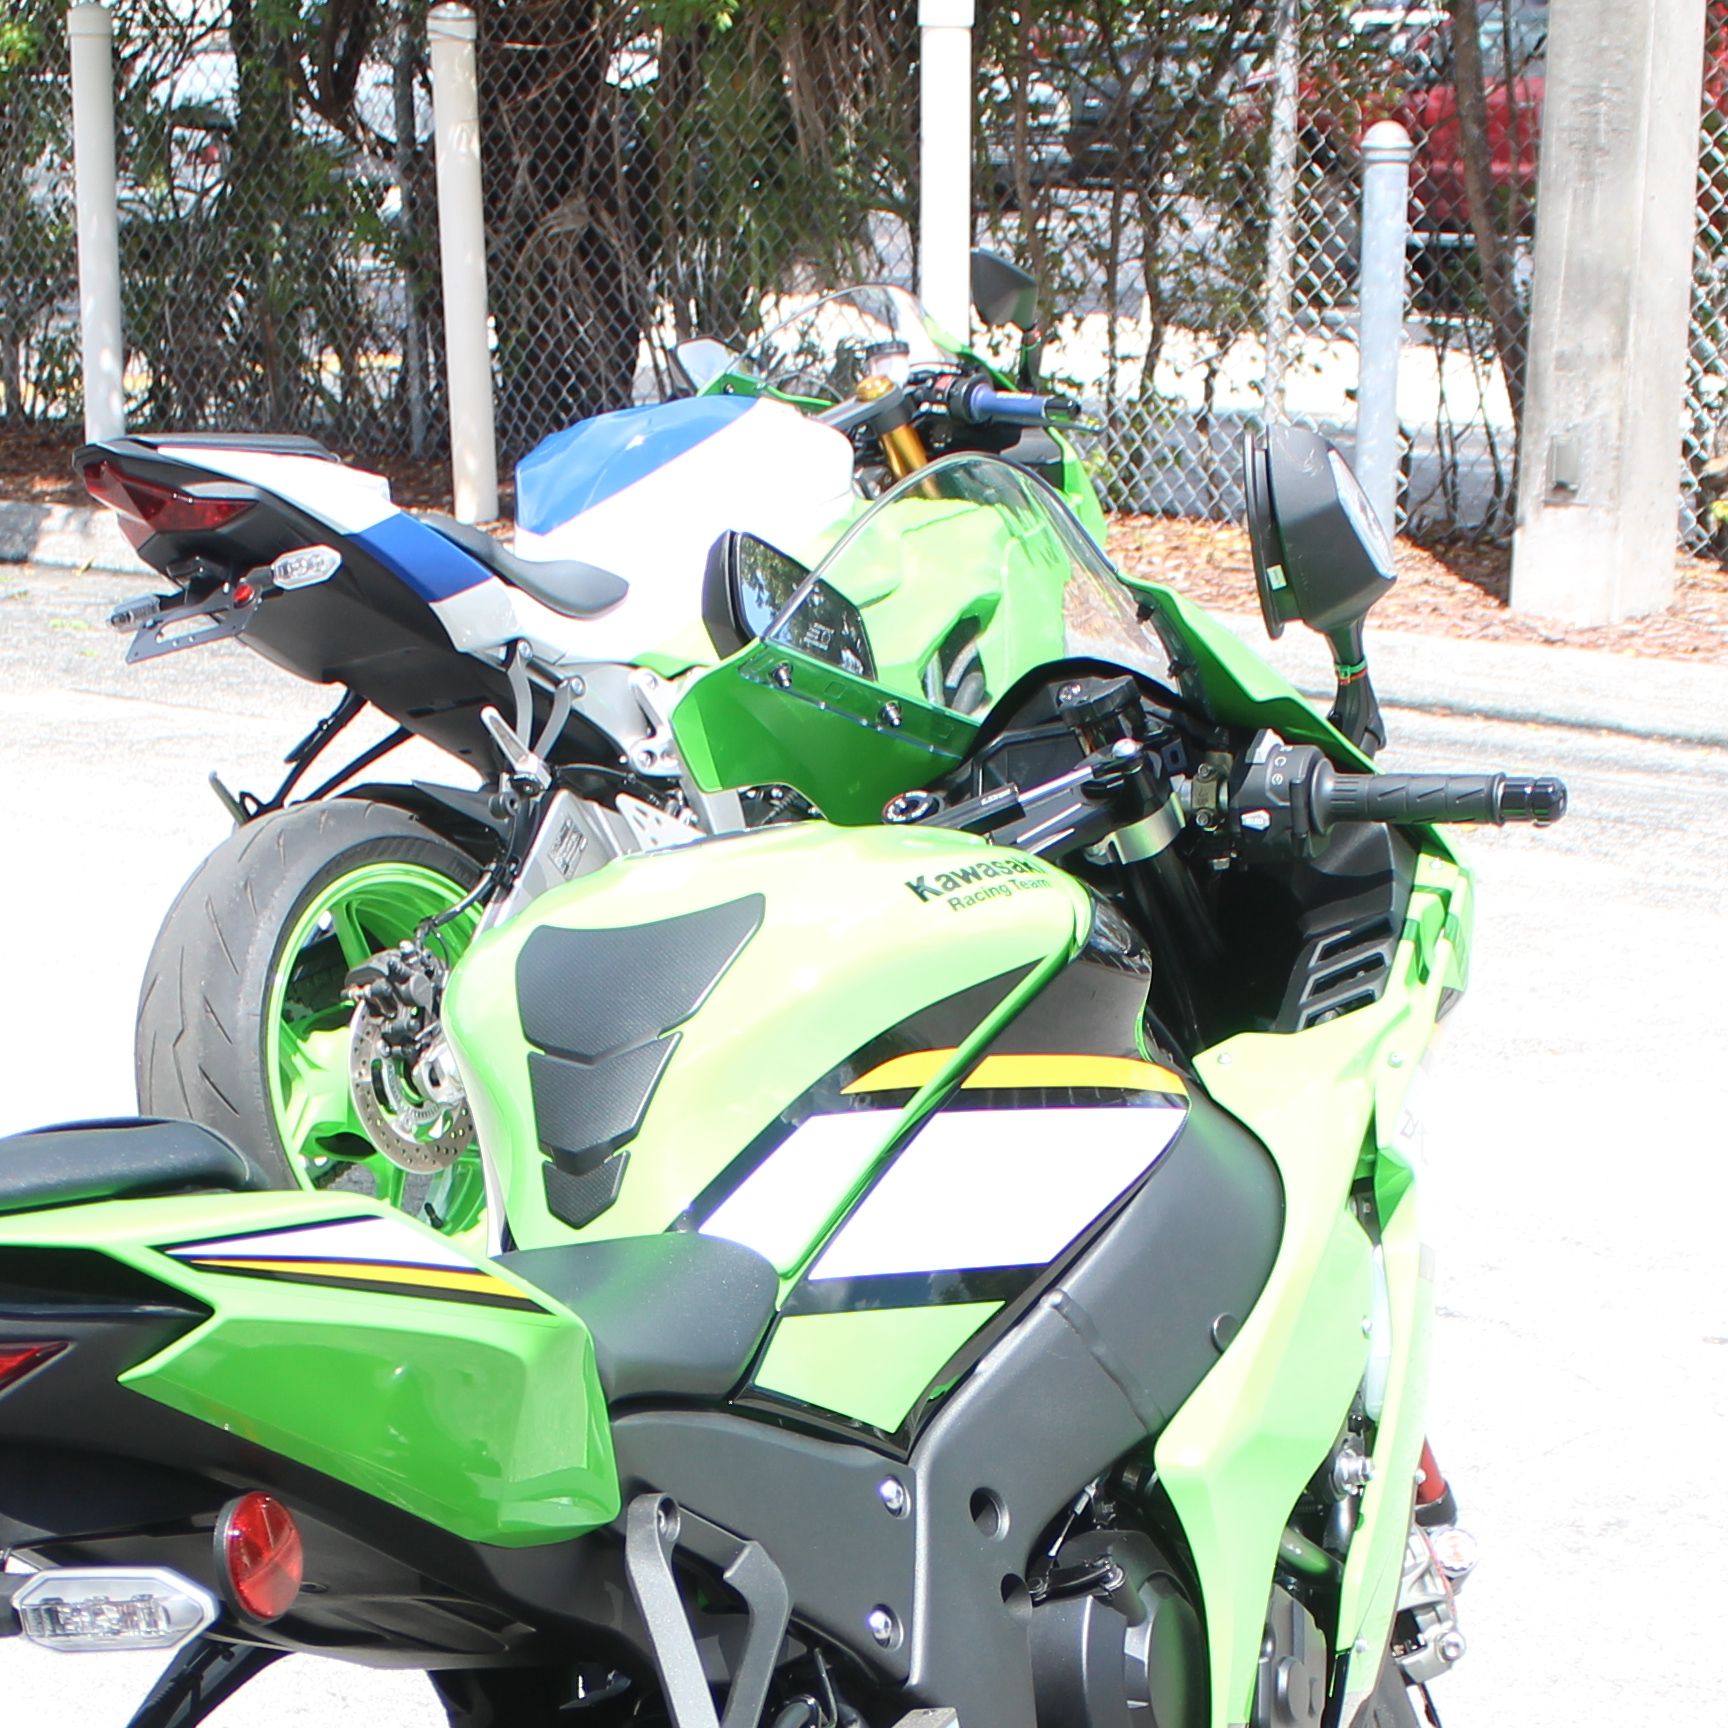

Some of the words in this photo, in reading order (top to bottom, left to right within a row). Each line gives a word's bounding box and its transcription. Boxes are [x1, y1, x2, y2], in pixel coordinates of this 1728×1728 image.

[904, 856, 1048, 903] Kawasaki
[946, 883, 1012, 912] Racing
[1007, 877, 1053, 892] Team
